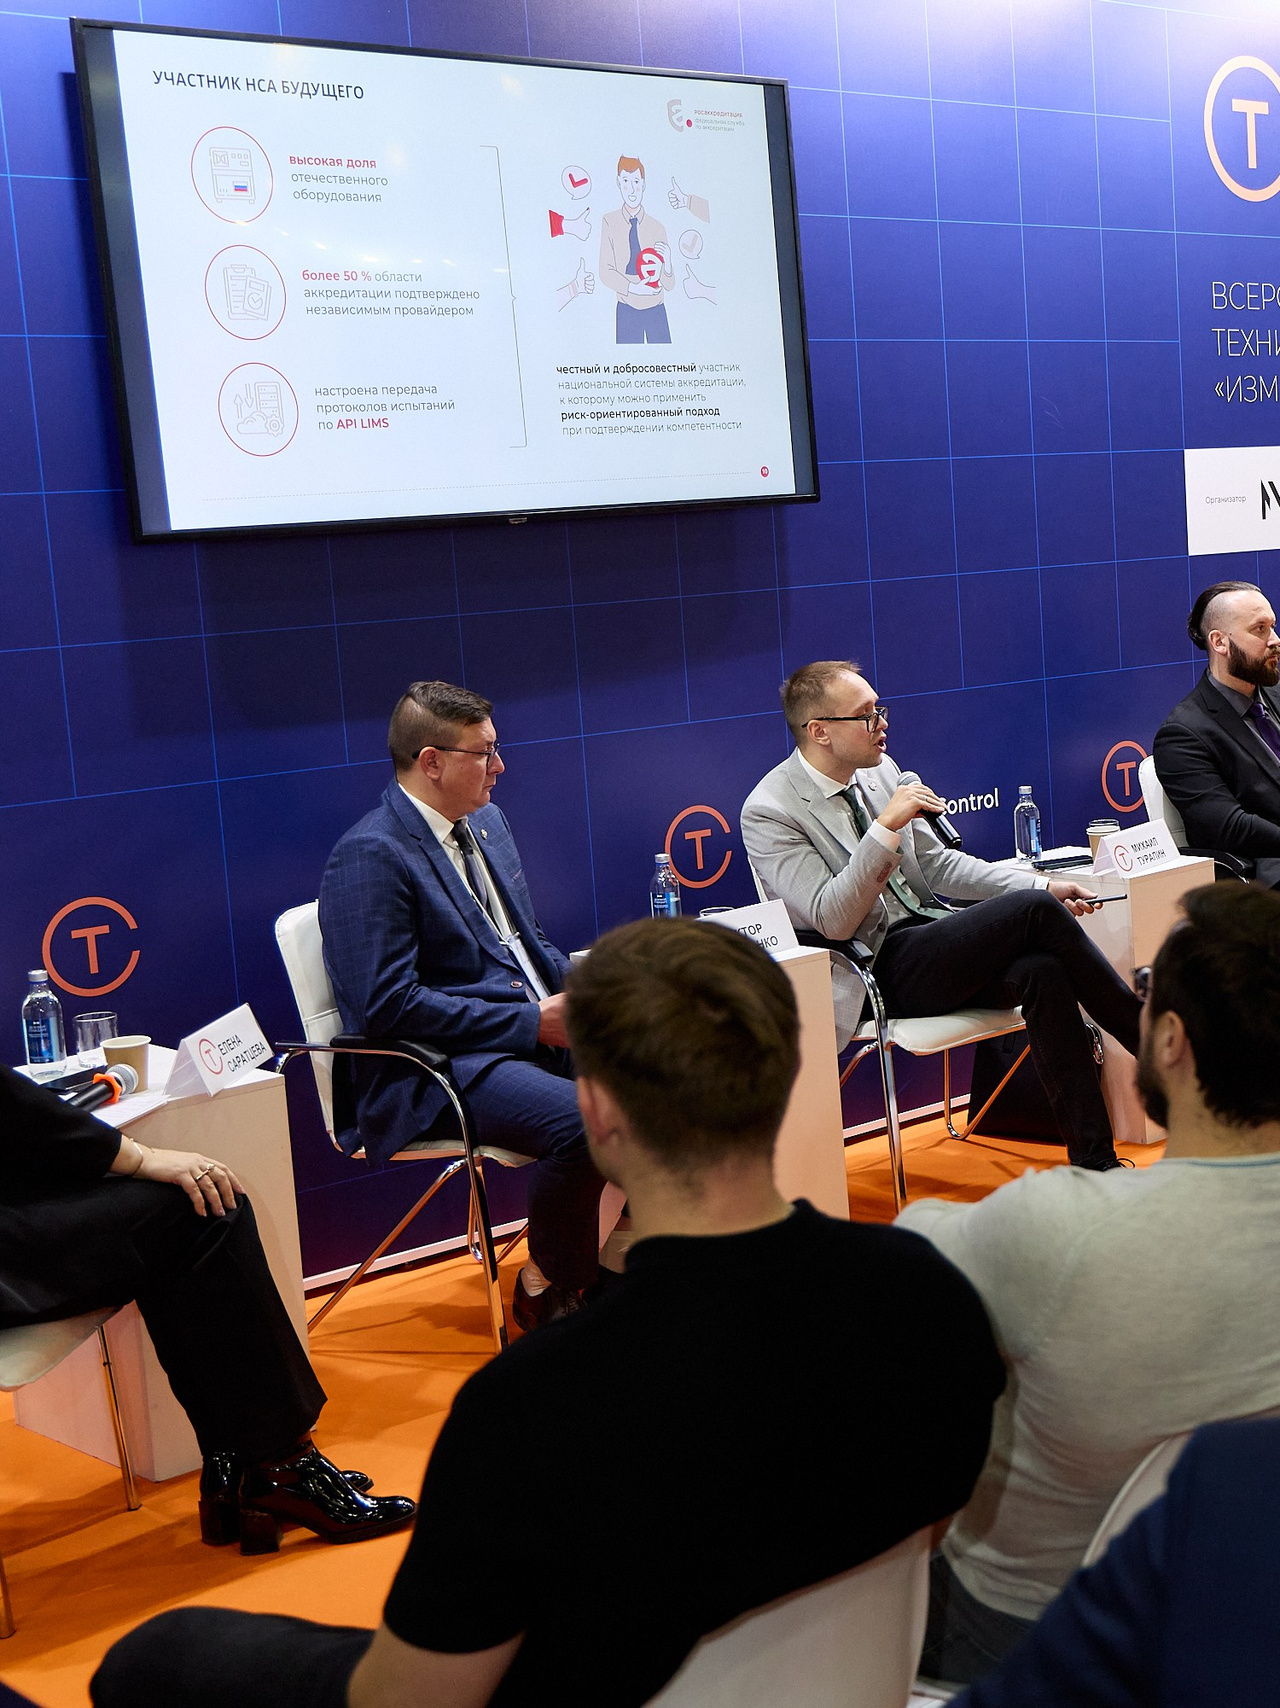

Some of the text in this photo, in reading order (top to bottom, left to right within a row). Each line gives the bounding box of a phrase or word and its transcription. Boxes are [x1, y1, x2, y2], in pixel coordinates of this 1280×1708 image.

[153, 70, 364, 101] УЧАСТНИК НСА БУДУЩЕГО
[289, 154, 377, 170] высокая доля
[291, 172, 388, 187] отечественного
[293, 189, 382, 203] оборудования
[302, 270, 422, 282] более 50 % области
[304, 287, 480, 301] аккредитации подтверждено
[306, 304, 474, 317] независимым провайдером
[556, 362, 741, 376] честный и добросовестный участник
[314, 384, 437, 398] настроена передача
[558, 377, 747, 391] национальной системы аккредитации,
[560, 392, 707, 407] к которому можно применить
[316, 400, 455, 414] протоколов испытаний
[561, 407, 720, 422] риск-ориентированный подход
[318, 417, 389, 431] по API LIMS
[562, 421, 742, 438] при подтверждении компетентности
[1205, 495, 1247, 505] Организатор
[1131, 837, 1158, 854] МИХАИЛ
[218, 1035, 243, 1056] ЕЛЕНА
[227, 1041, 267, 1073] САРАТЦЕВА
